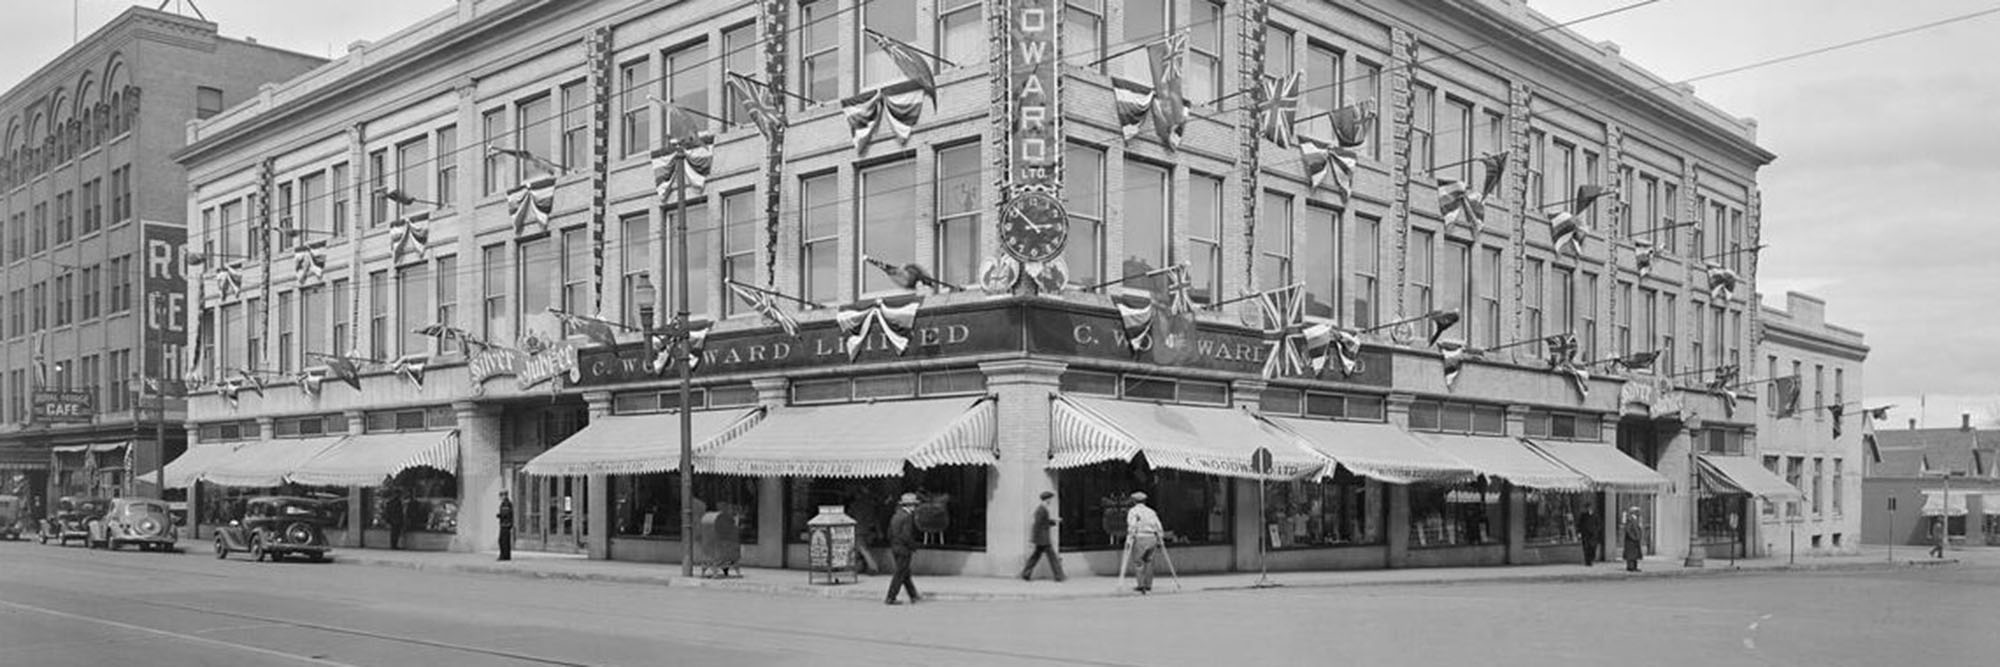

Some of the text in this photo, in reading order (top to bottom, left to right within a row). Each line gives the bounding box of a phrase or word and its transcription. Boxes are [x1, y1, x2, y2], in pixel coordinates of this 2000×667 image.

[621, 341, 791, 375] WOWARD
[1073, 324, 1264, 362] C. WOWAR
[46, 403, 80, 417] CAFE
